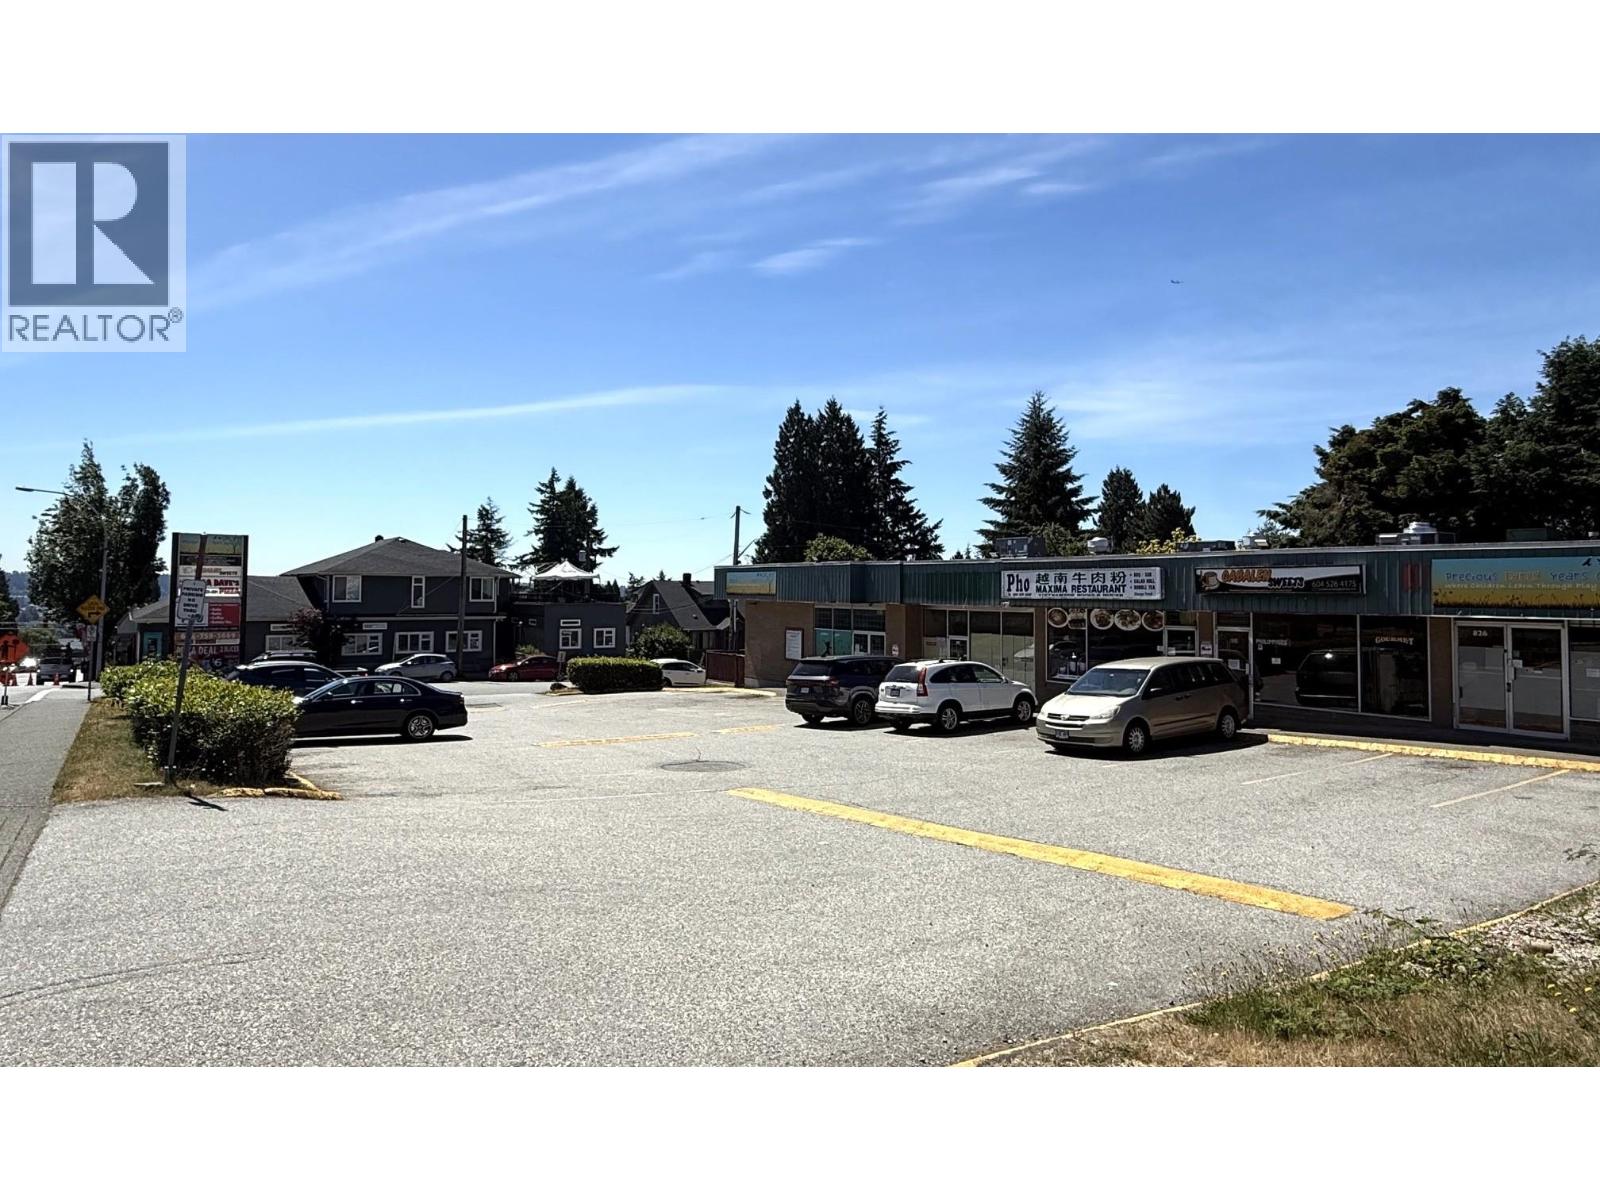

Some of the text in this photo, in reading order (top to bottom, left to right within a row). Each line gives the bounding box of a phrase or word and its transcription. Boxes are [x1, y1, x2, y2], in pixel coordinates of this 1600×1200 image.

[1035, 570, 1127, 585] 越南牛肉粉
[1446, 571, 1498, 582] Precious
[1550, 571, 1588, 581] Years
[1006, 573, 1030, 592] Pho
[1311, 580, 1325, 588] 604
[1575, 583, 1598, 591] Play
[1035, 584, 1127, 594] MAXIMA RESTAURANT
